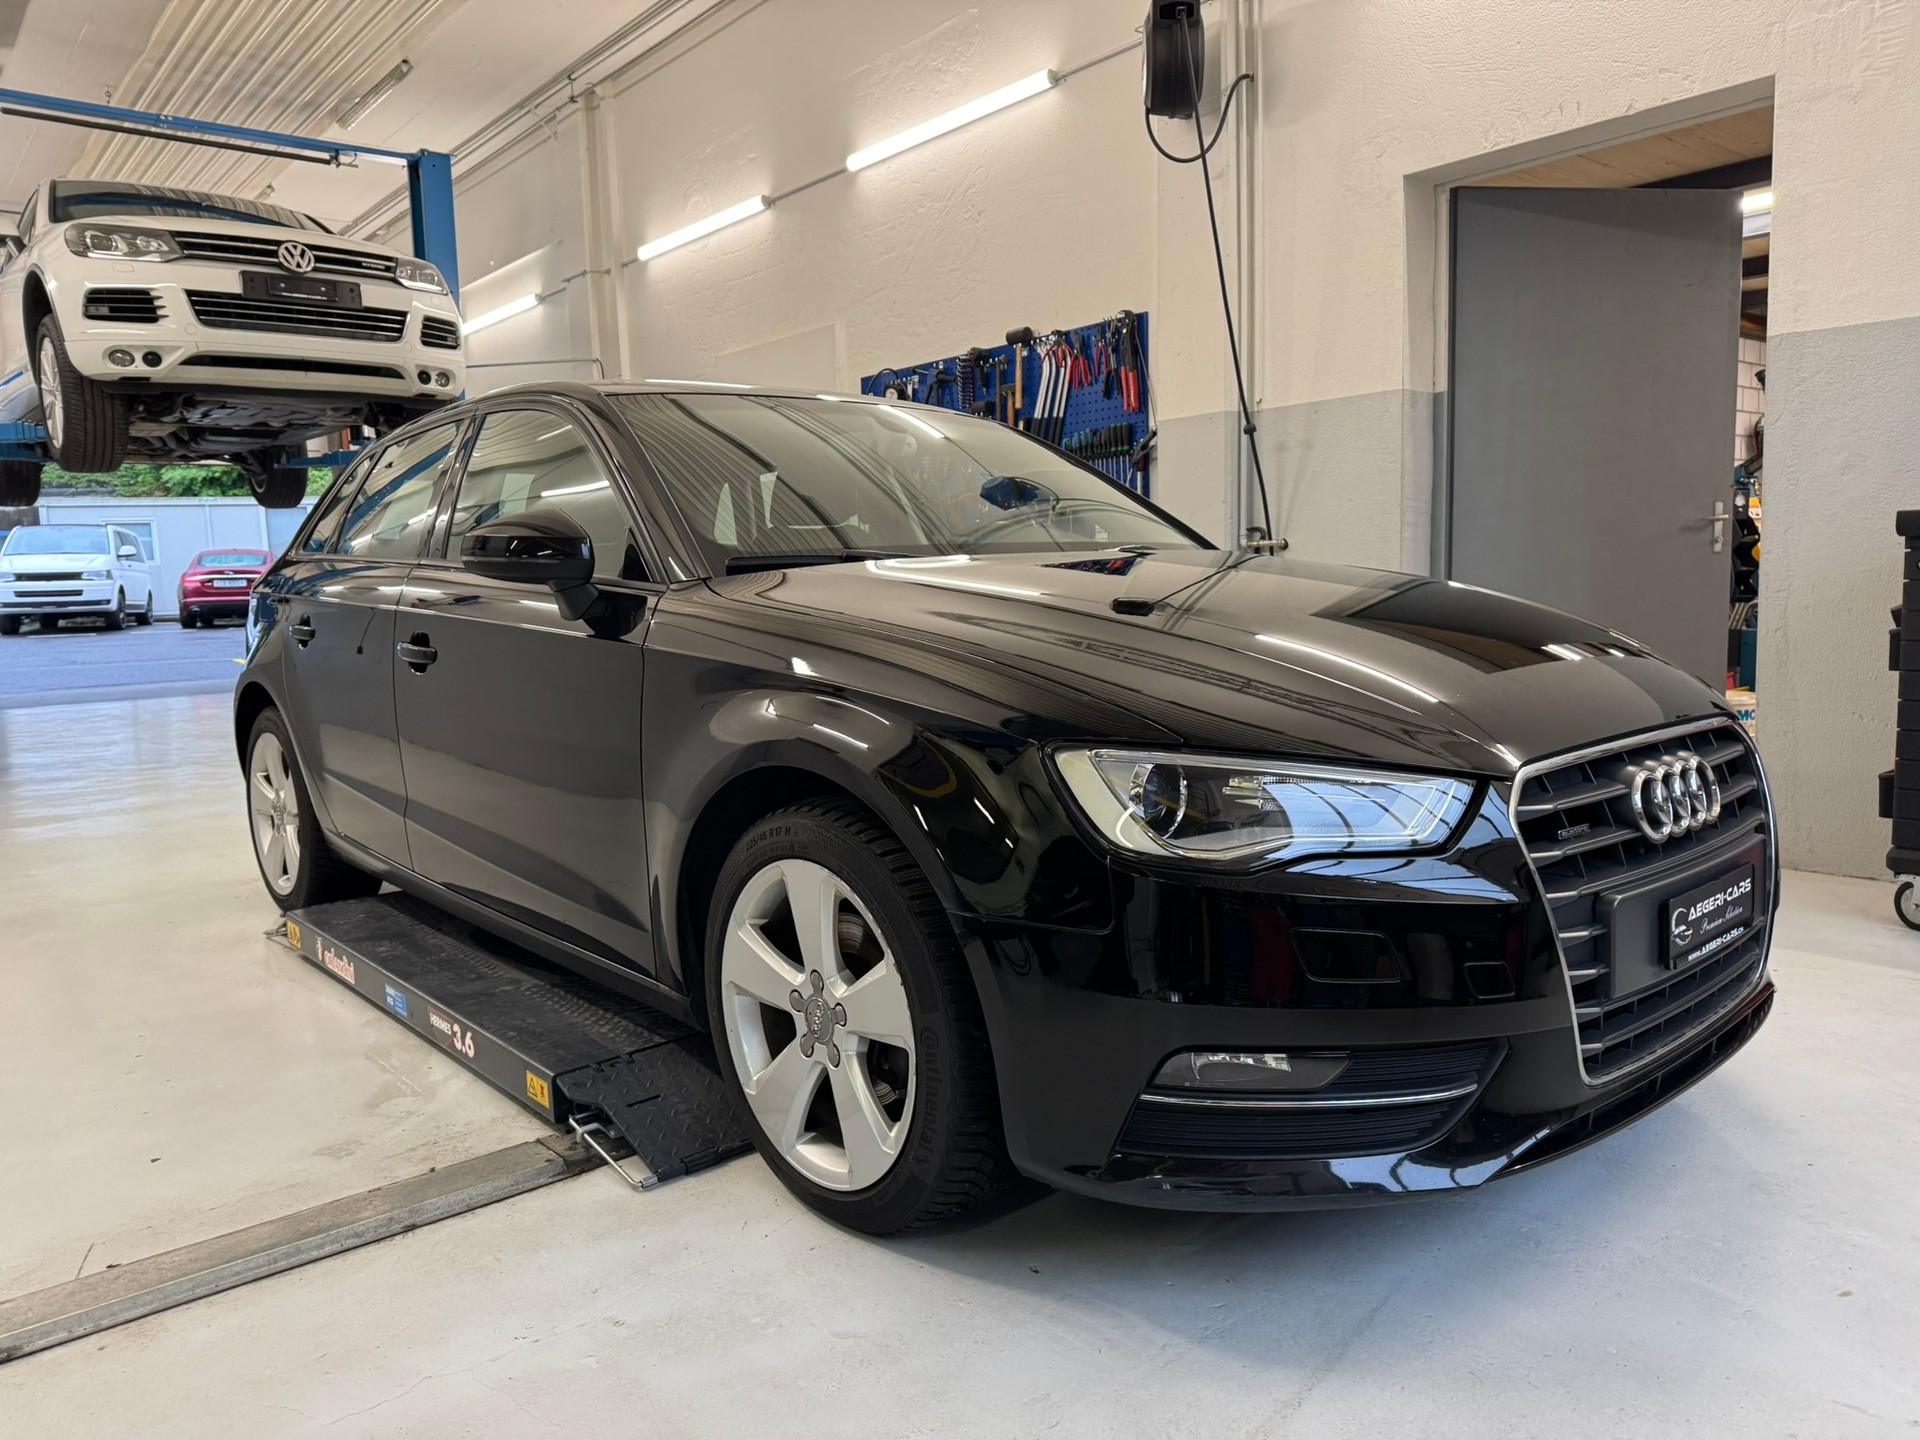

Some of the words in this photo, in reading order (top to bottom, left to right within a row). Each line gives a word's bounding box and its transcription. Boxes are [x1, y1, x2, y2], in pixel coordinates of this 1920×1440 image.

[745, 830, 768, 852] 225/45
[1688, 878, 1752, 922] AEGERI-CARS
[430, 1012, 452, 1036] HERMES
[452, 1023, 475, 1059] 3.6
